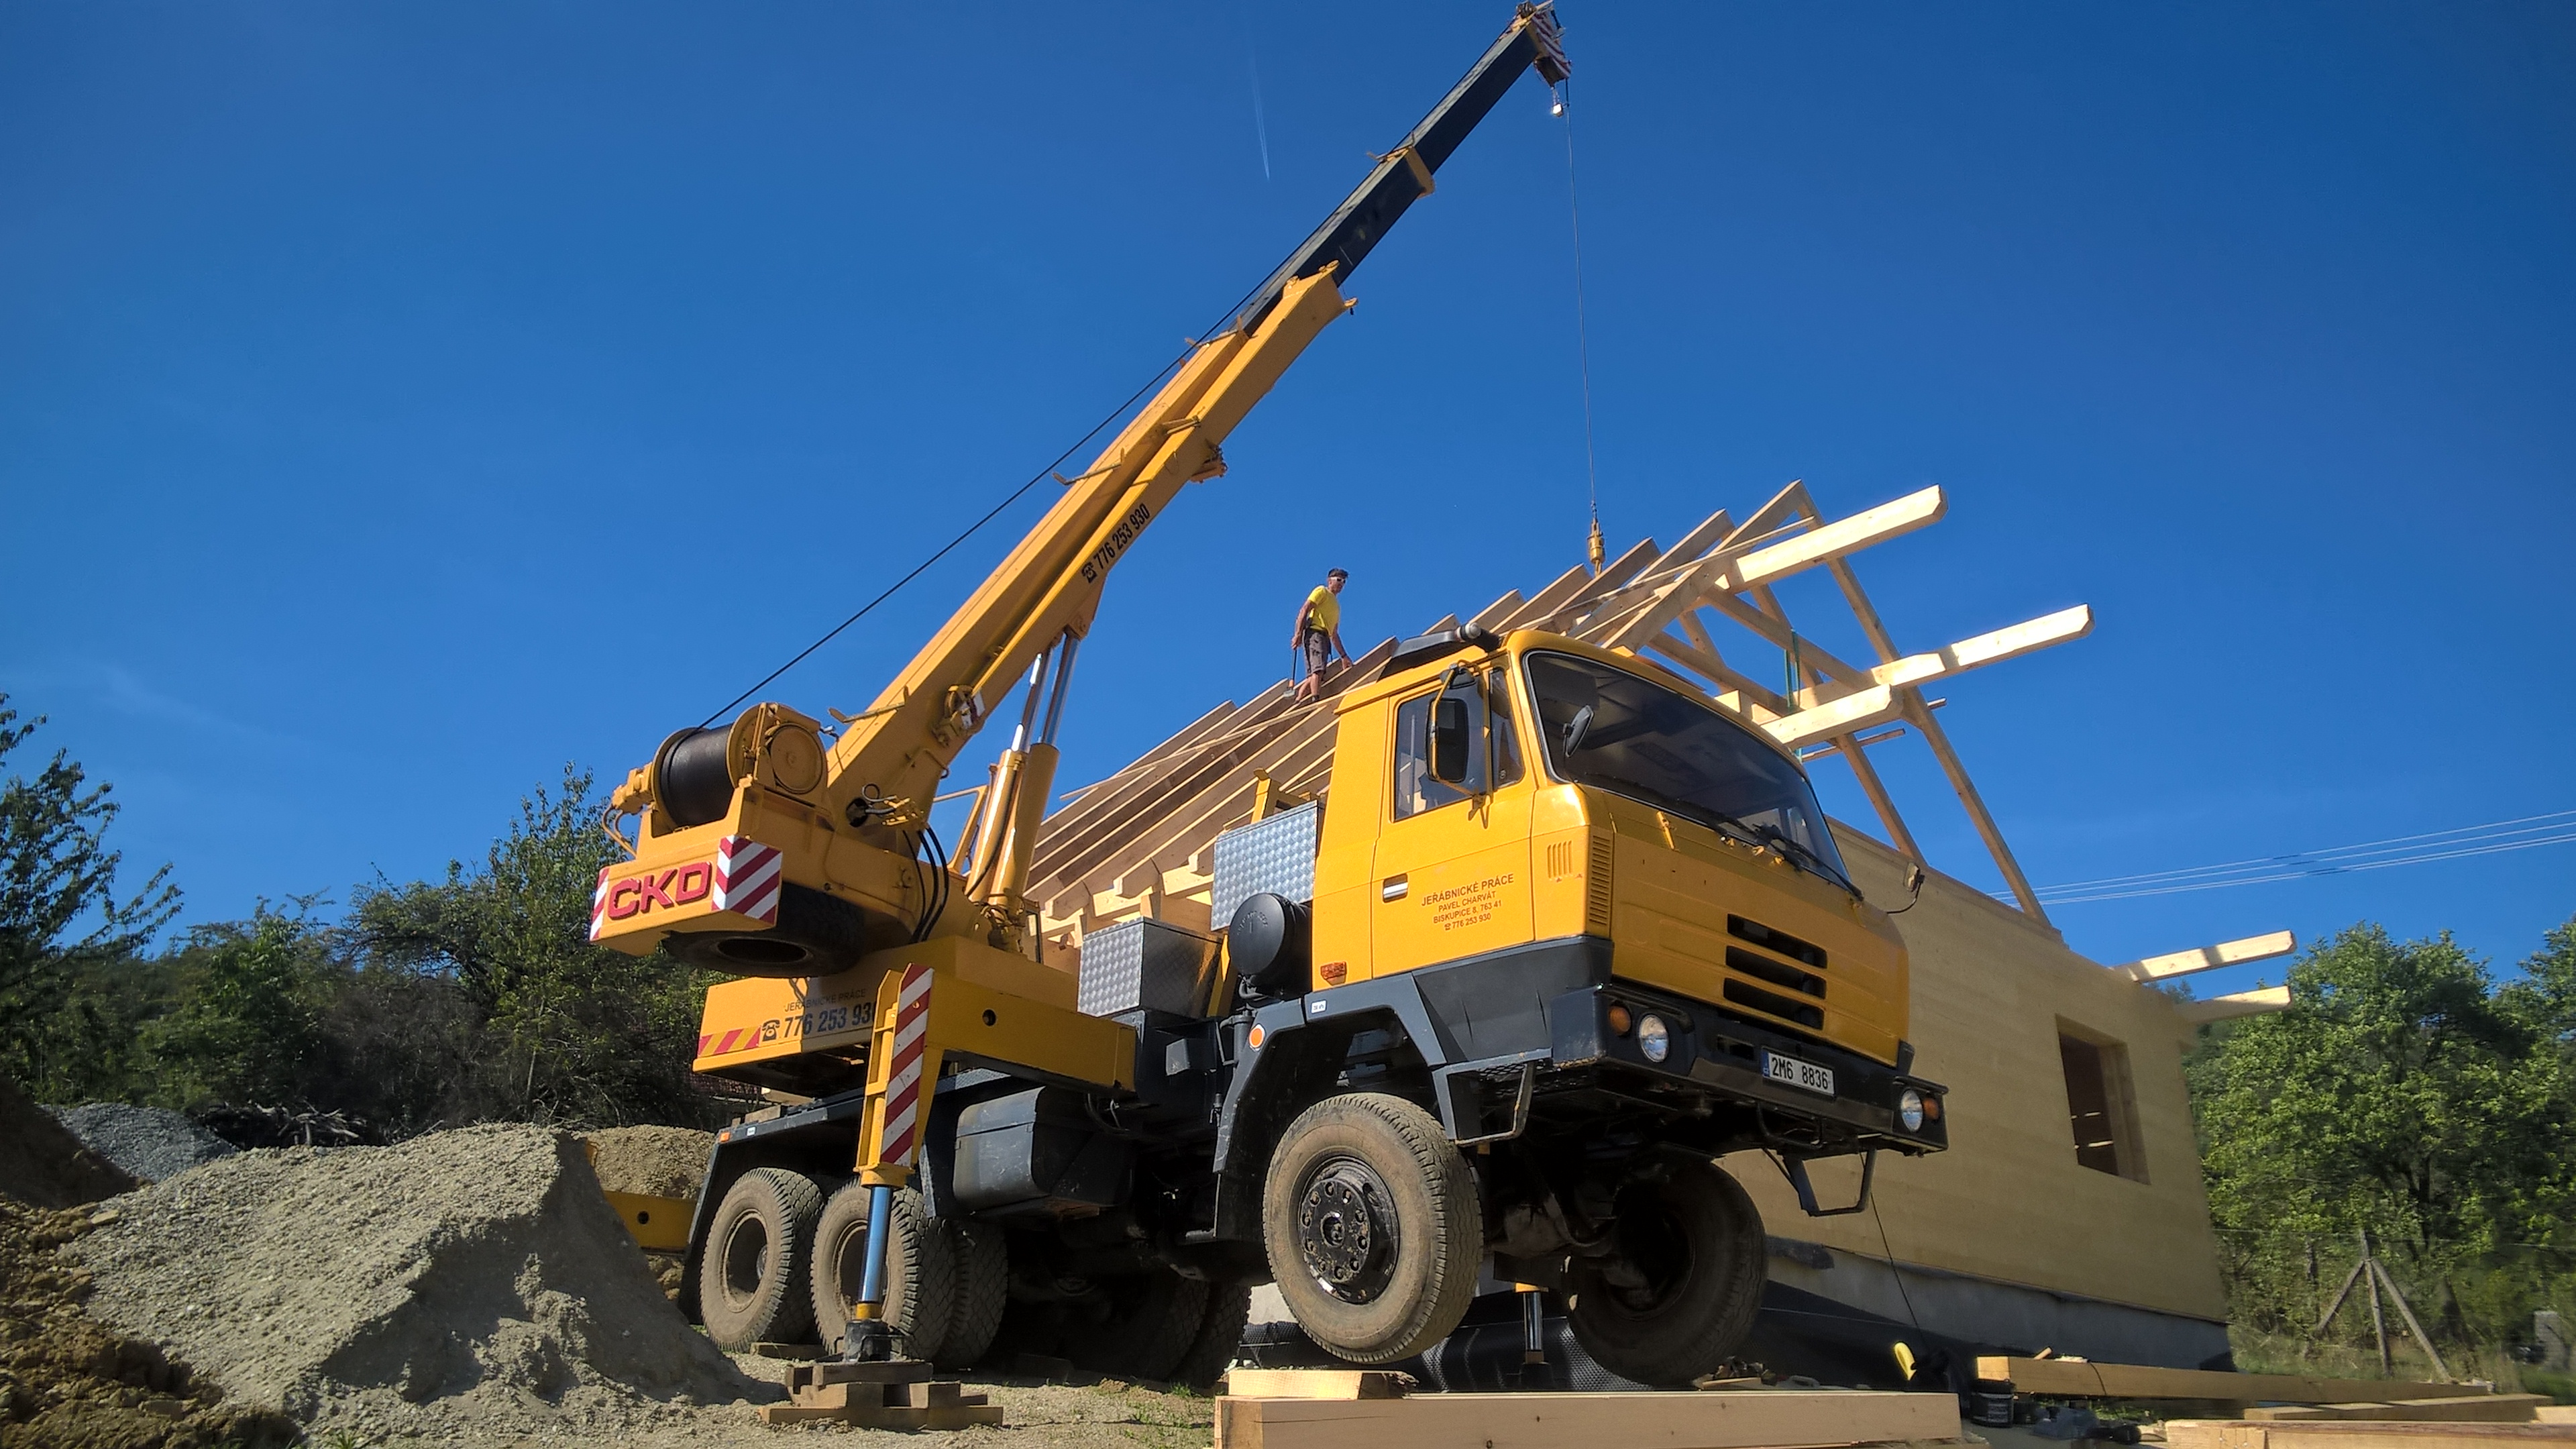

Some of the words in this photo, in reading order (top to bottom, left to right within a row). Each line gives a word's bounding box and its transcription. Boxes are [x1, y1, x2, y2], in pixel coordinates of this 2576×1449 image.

[1093, 542, 1116, 570] 776
[1112, 523, 1133, 550] 253
[1130, 503, 1150, 530] 930
[1421, 881, 1479, 906] JEŘÁBNICKÉ
[1481, 873, 1514, 890] PRÁCE
[1438, 901, 1460, 912] PAVEL
[1462, 891, 1496, 906] CHARVÁT
[1433, 908, 1470, 924] BISKUPICE
[1480, 902, 1493, 911] 763
[1493, 900, 1502, 908] 41
[1452, 920, 1464, 928] 776
[1465, 916, 1478, 926] 253
[1479, 912, 1491, 922] 930
[784, 1013, 813, 1038] 776
[818, 1007, 847, 1032] 253
[1772, 1057, 1793, 1080] 2M6
[1802, 1065, 1828, 1089] 8836
